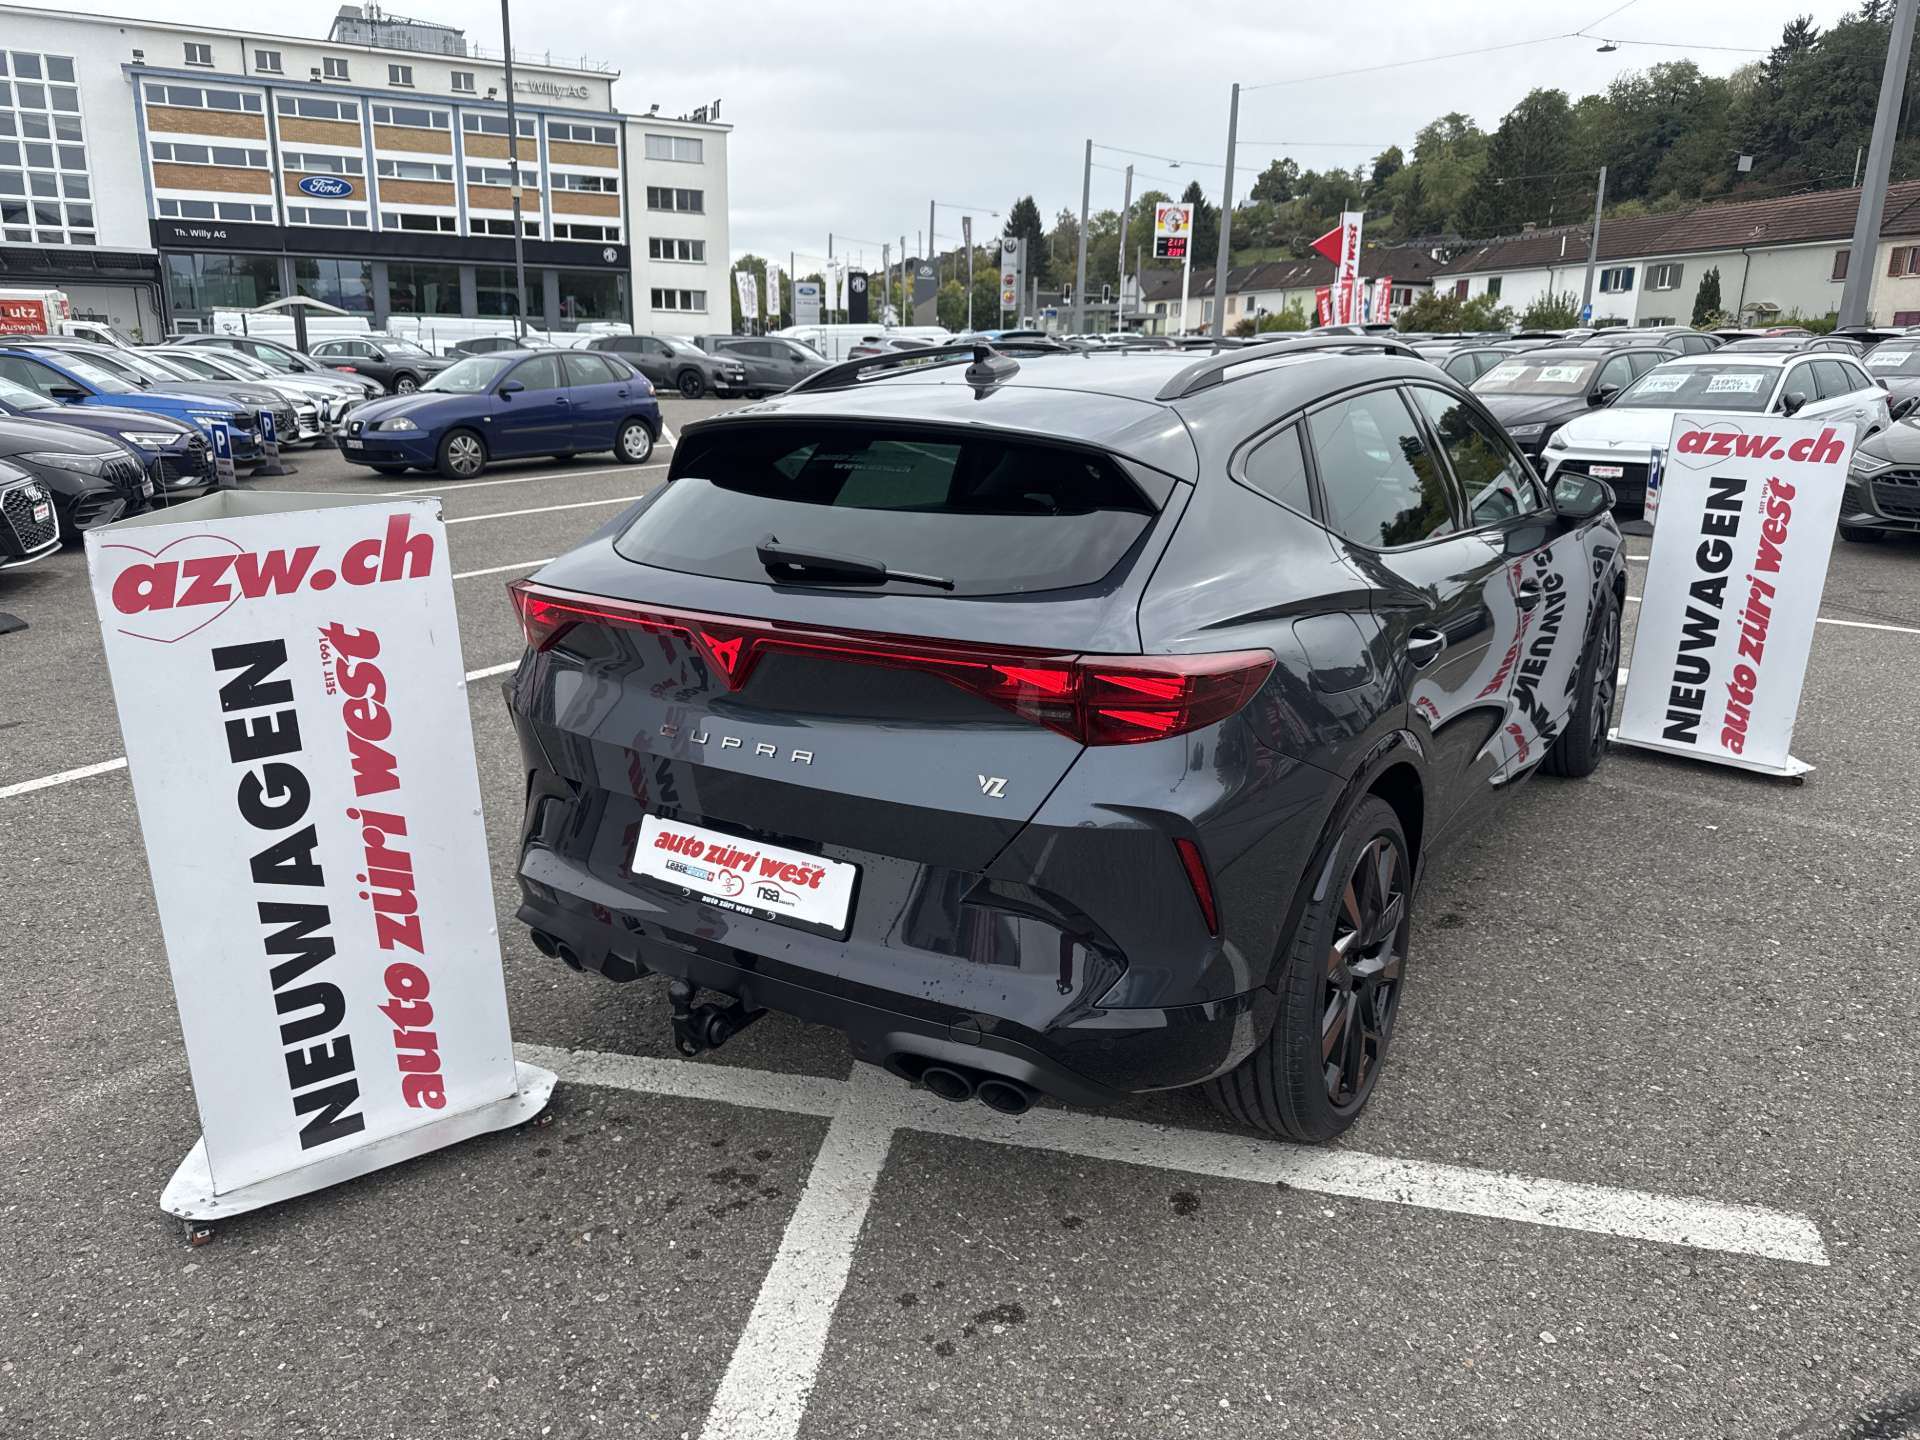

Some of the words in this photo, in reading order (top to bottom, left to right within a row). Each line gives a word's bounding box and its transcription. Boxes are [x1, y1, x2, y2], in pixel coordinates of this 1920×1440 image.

[529, 80, 563, 100] Willy
[567, 84, 590, 99] AG
[309, 178, 343, 195] Ford
[174, 228, 188, 237] Th.
[190, 229, 211, 239] Willy
[213, 231, 227, 239] AG
[852, 277, 866, 293] MG
[215, 430, 226, 453] P
[263, 417, 271, 437] P
[1676, 428, 1846, 464] azw.ch
[1754, 476, 1797, 574] west
[112, 513, 434, 615] azw.ch
[1662, 476, 1747, 744] NEUWAGEN
[1737, 574, 1776, 666] züri
[318, 636, 332, 666] 1991
[325, 670, 337, 695] SEIT
[318, 621, 401, 797] west
[1721, 664, 1757, 755] auto
[659, 724, 814, 766] CUPRA
[977, 774, 1009, 799] VZ
[654, 831, 705, 860] auto
[704, 844, 760, 872] züri
[759, 857, 826, 889] west
[211, 638, 366, 1151] NEUWAGEN
[345, 807, 425, 955] züri
[756, 886, 780, 903] nsa
[701, 895, 717, 906] auto
[718, 900, 735, 911] züri
[735, 903, 754, 915] west
[378, 962, 447, 1110] auto
